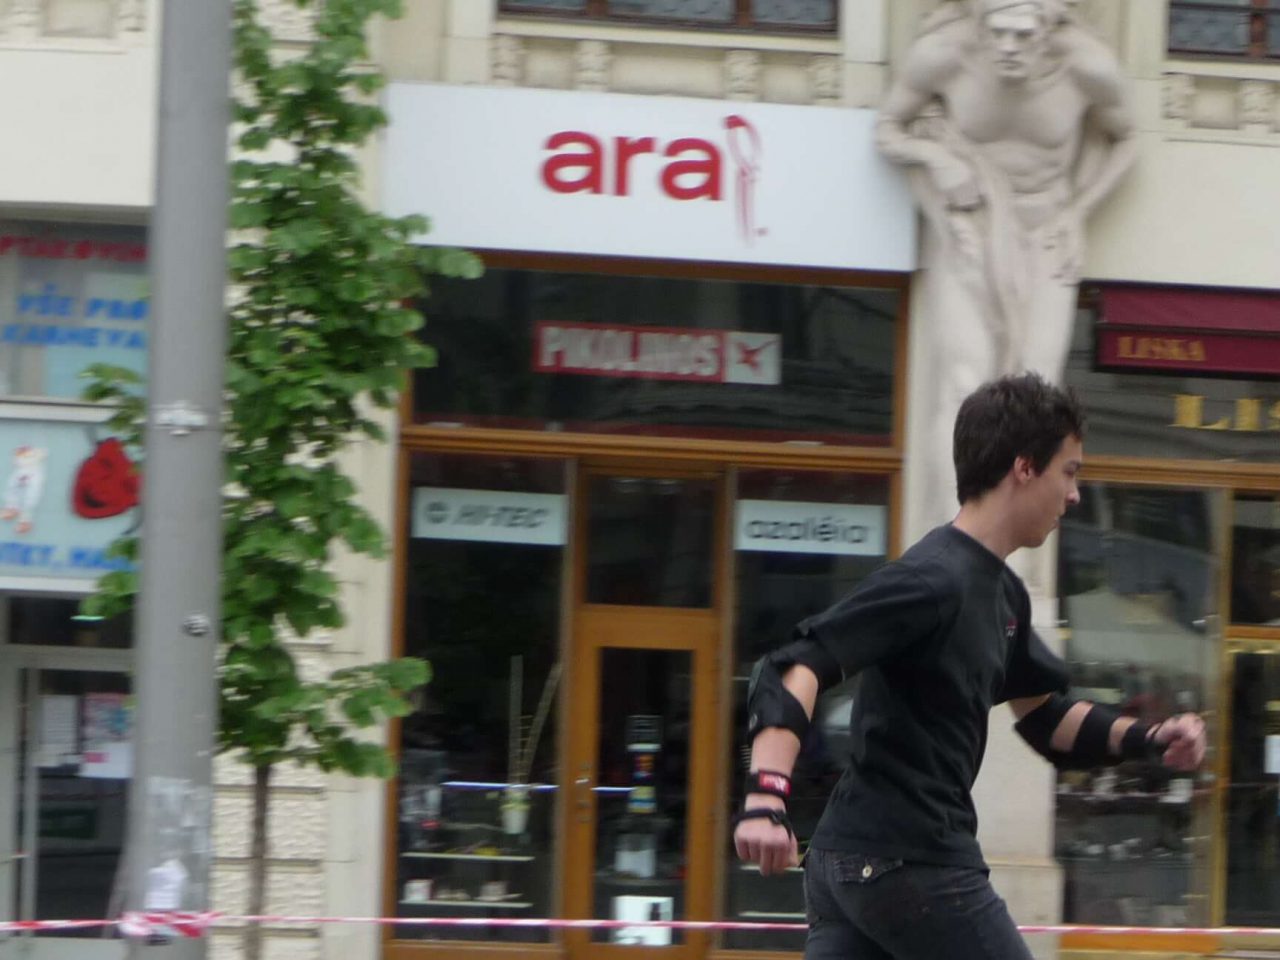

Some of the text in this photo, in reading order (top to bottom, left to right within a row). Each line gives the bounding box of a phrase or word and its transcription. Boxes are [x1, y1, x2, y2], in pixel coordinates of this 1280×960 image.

[540, 131, 724, 201] ara
[1116, 336, 1207, 362] LISKA
[744, 513, 872, 545] azaléia
